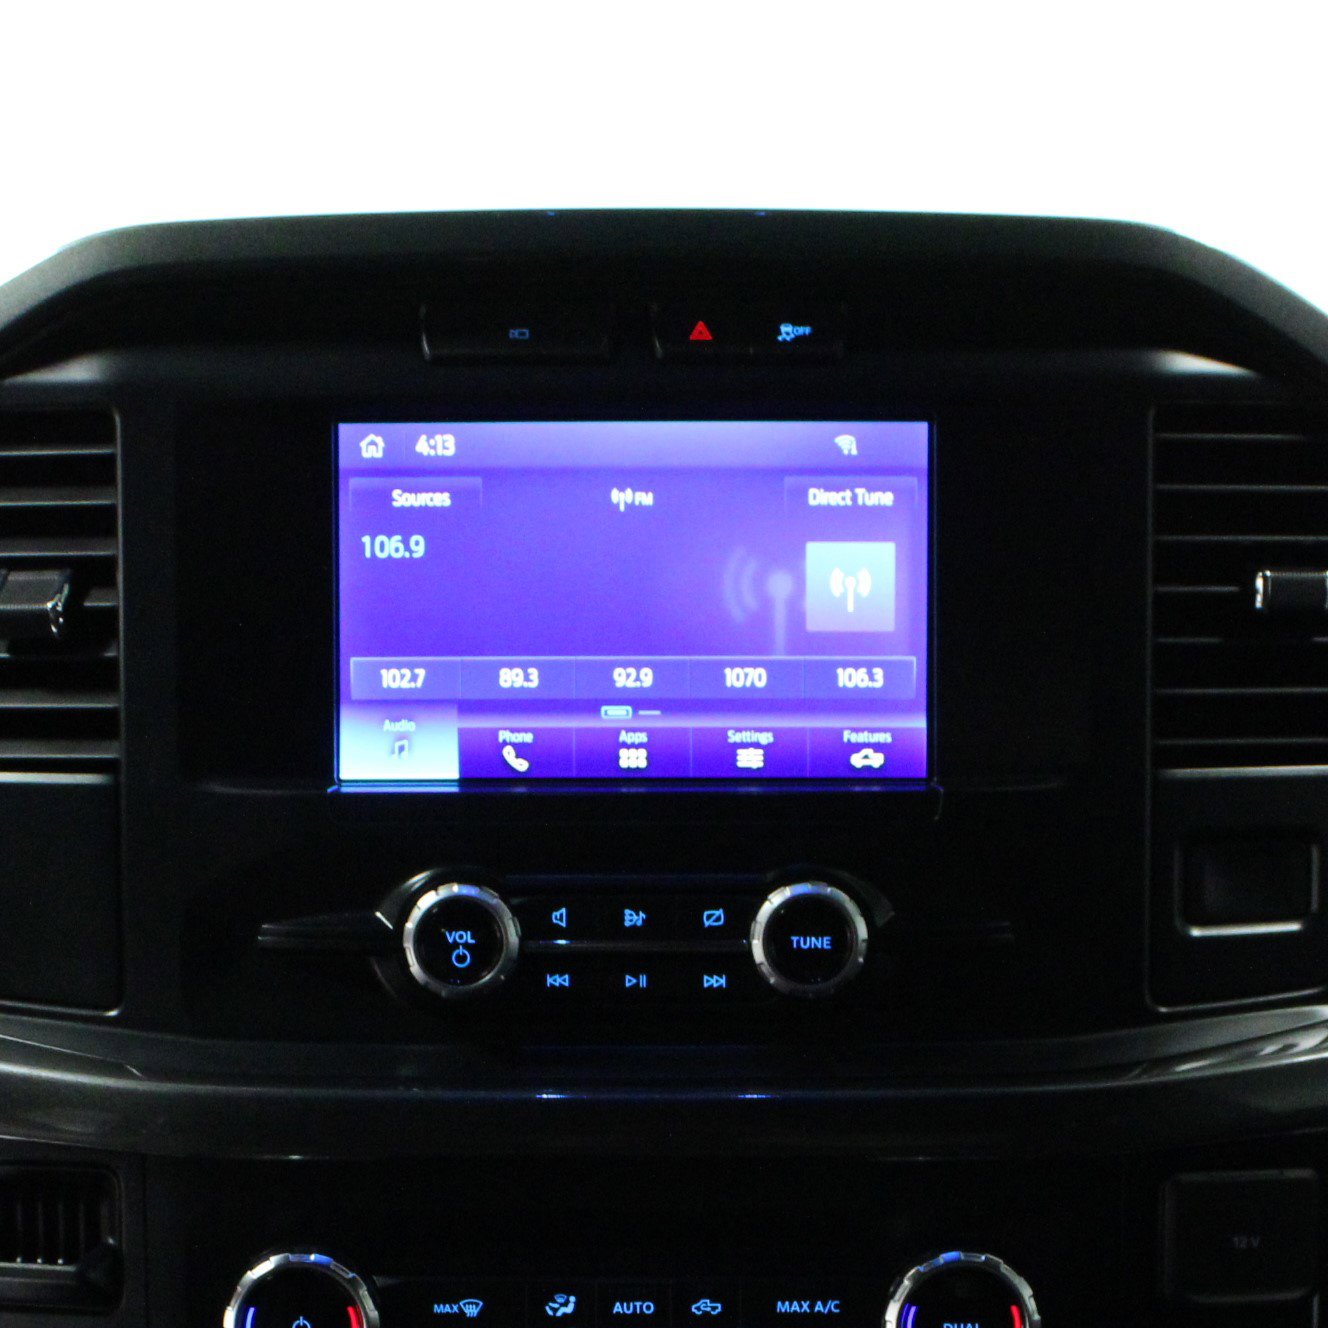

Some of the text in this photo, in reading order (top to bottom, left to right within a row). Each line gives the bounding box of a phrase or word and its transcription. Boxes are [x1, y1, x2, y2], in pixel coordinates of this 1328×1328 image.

[415, 434, 455, 456] 4:13
[392, 489, 451, 507] Sources
[634, 491, 654, 506] FM
[808, 488, 894, 506] Direct Tune
[362, 535, 425, 558] 106.9
[380, 668, 426, 688] 102.7
[499, 668, 539, 688] 89.3
[613, 668, 653, 688] 92.9
[724, 667, 767, 688] 1070
[836, 668, 884, 688] 106.3
[382, 719, 416, 733] Audio
[498, 729, 533, 743] Phone
[619, 729, 648, 745] Apps
[727, 729, 774, 745] Settings
[843, 729, 892, 743] Features
[446, 931, 475, 944] VOL
[791, 936, 831, 949] TUNE
[433, 1303, 459, 1314] MAX
[613, 1301, 655, 1314] AUTO
[777, 1300, 840, 1314] MAX A/C
